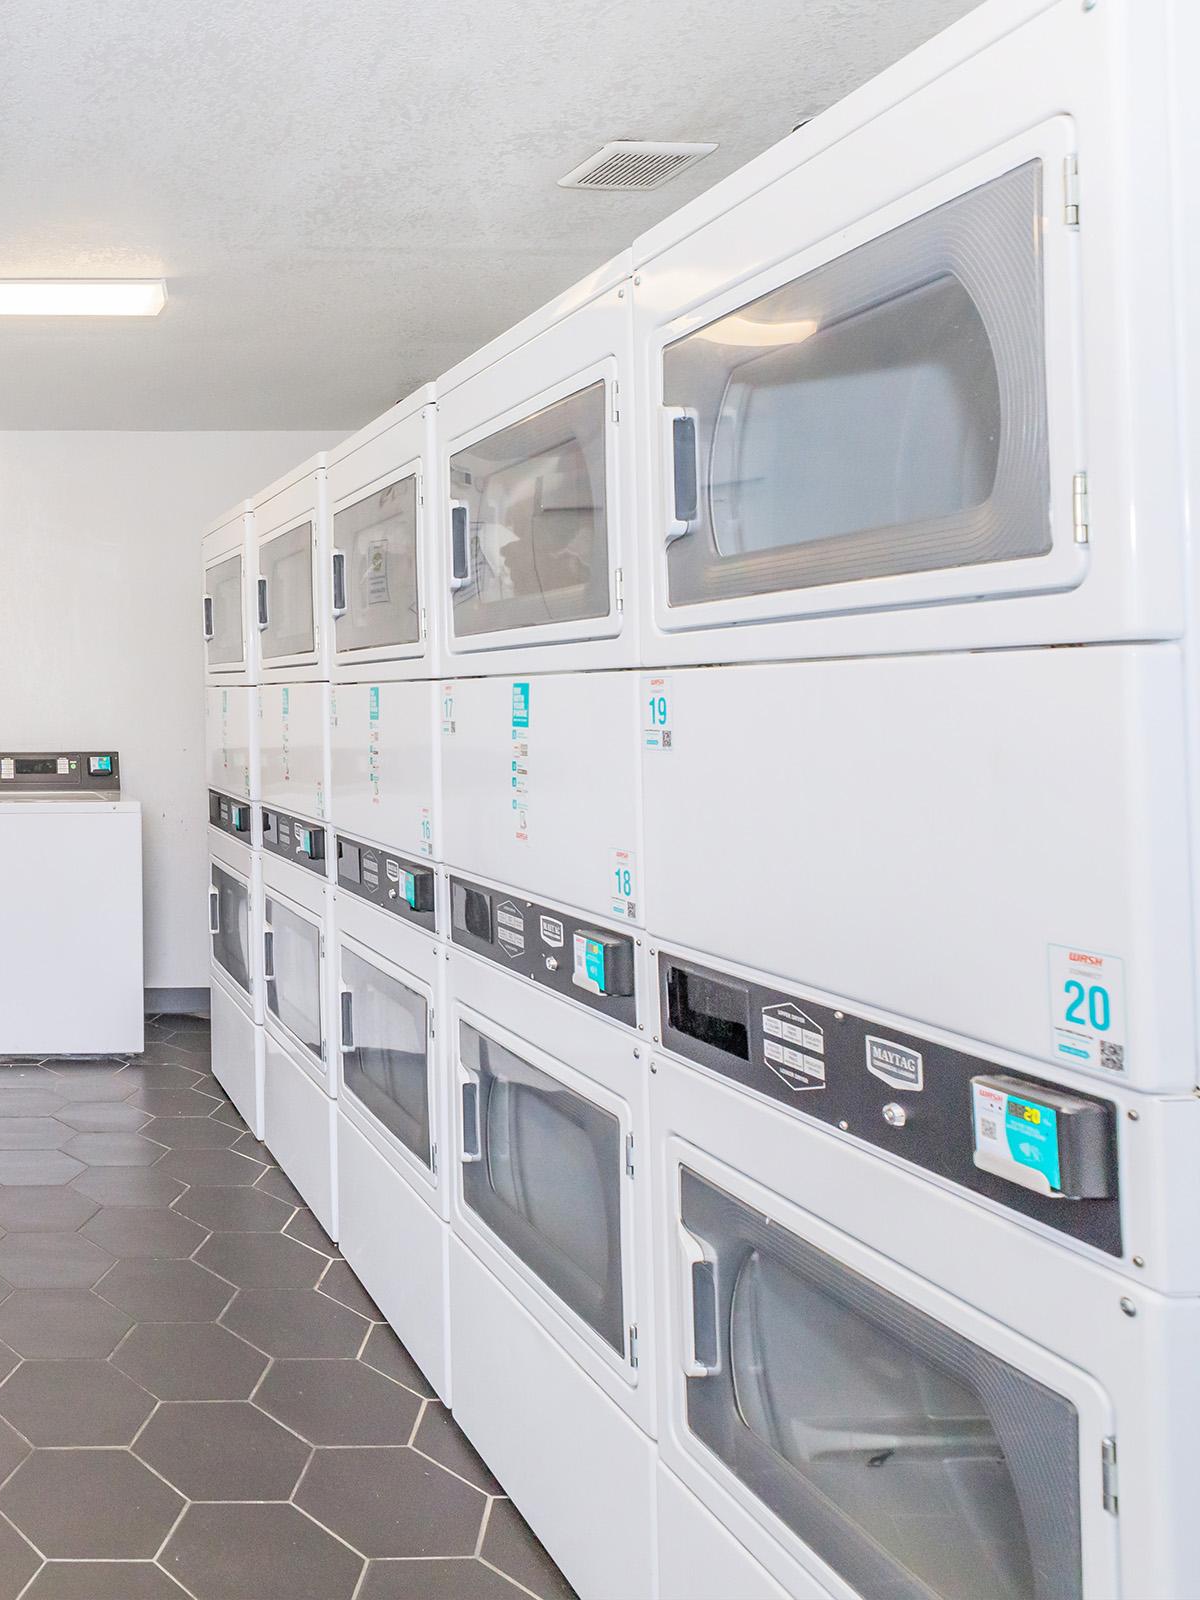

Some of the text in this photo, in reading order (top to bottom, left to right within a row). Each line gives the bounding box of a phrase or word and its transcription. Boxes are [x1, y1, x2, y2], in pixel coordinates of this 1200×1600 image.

[649, 696, 667, 725] 19
[422, 820, 431, 839] 16
[615, 868, 632, 897] 18
[1064, 979, 1110, 1031] 20
[872, 1046, 916, 1072] MAYTAG
[1023, 1105, 1041, 1125] 20
